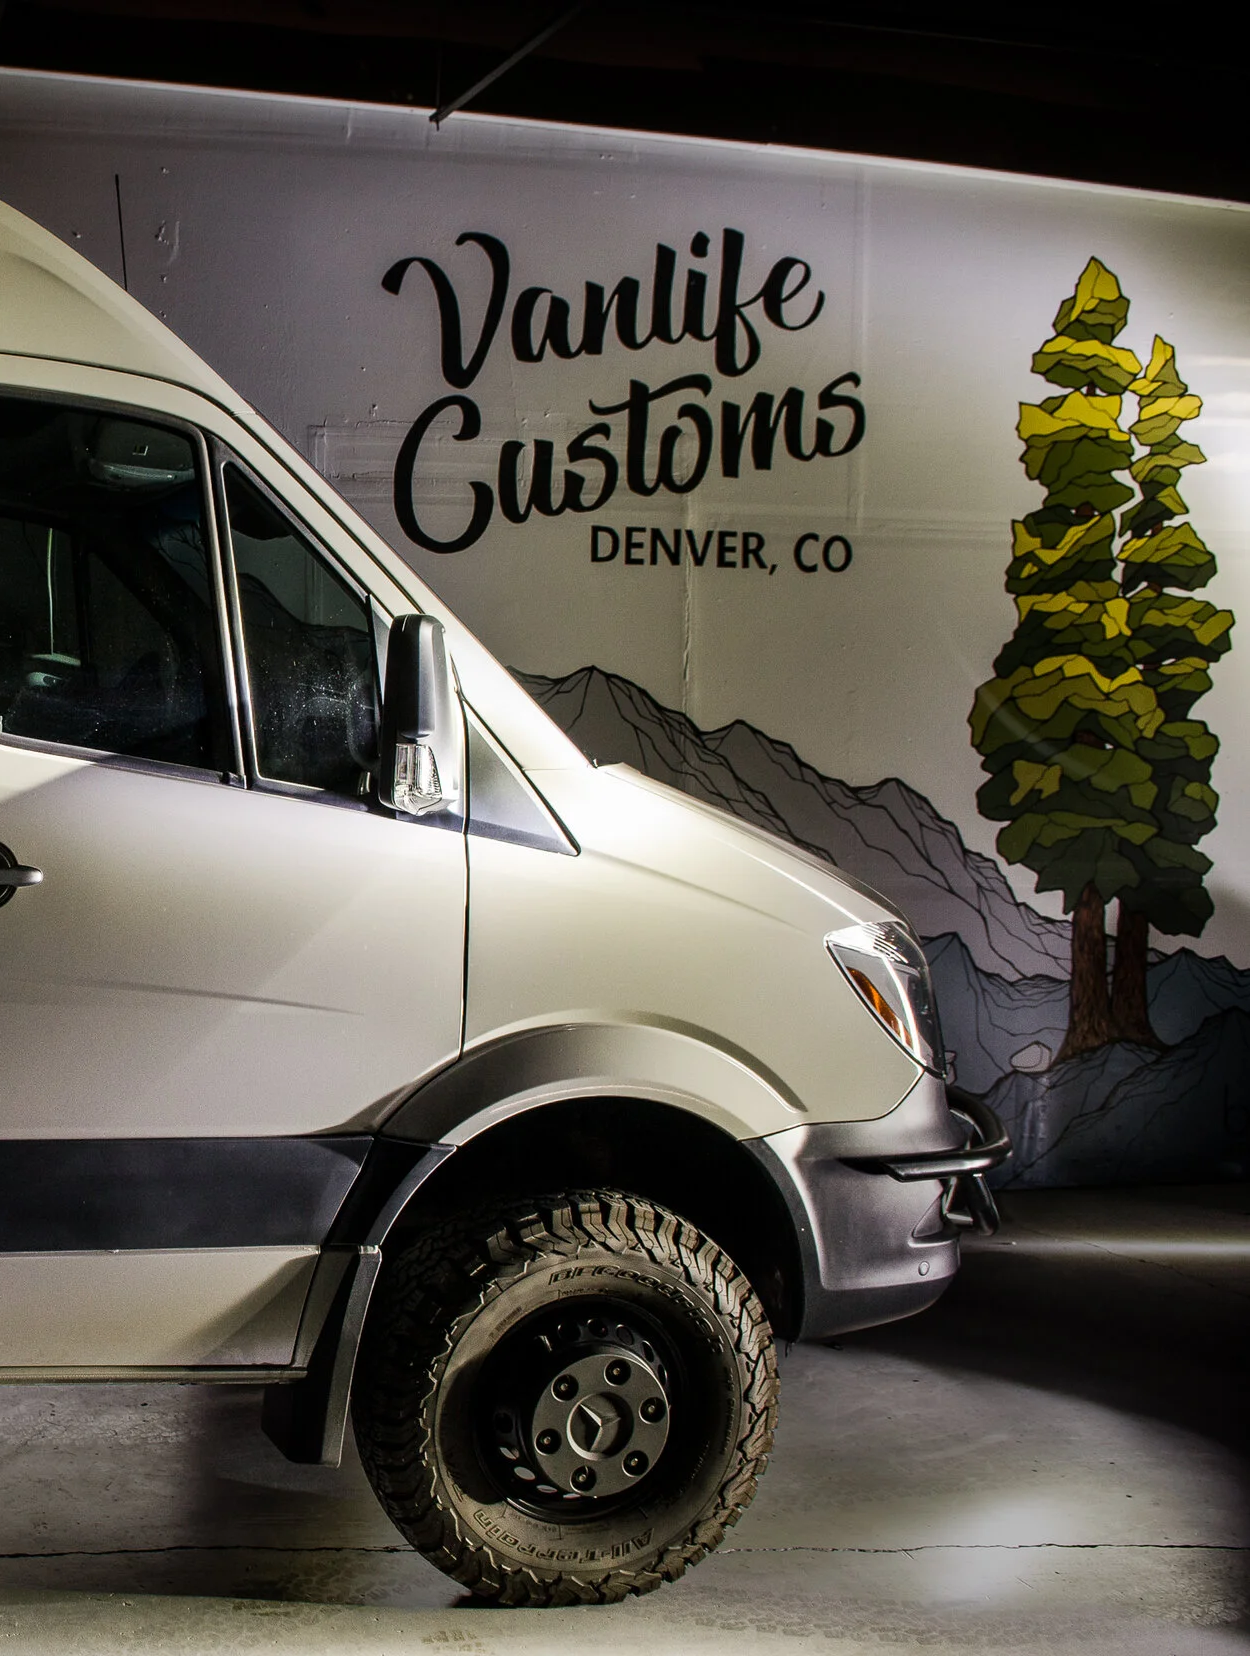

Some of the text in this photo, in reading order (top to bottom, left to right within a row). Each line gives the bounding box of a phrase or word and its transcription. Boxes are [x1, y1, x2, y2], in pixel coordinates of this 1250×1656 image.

[380, 227, 826, 390] Vanlife
[392, 371, 866, 555] Customs
[590, 525, 853, 576] DENVER, CO
